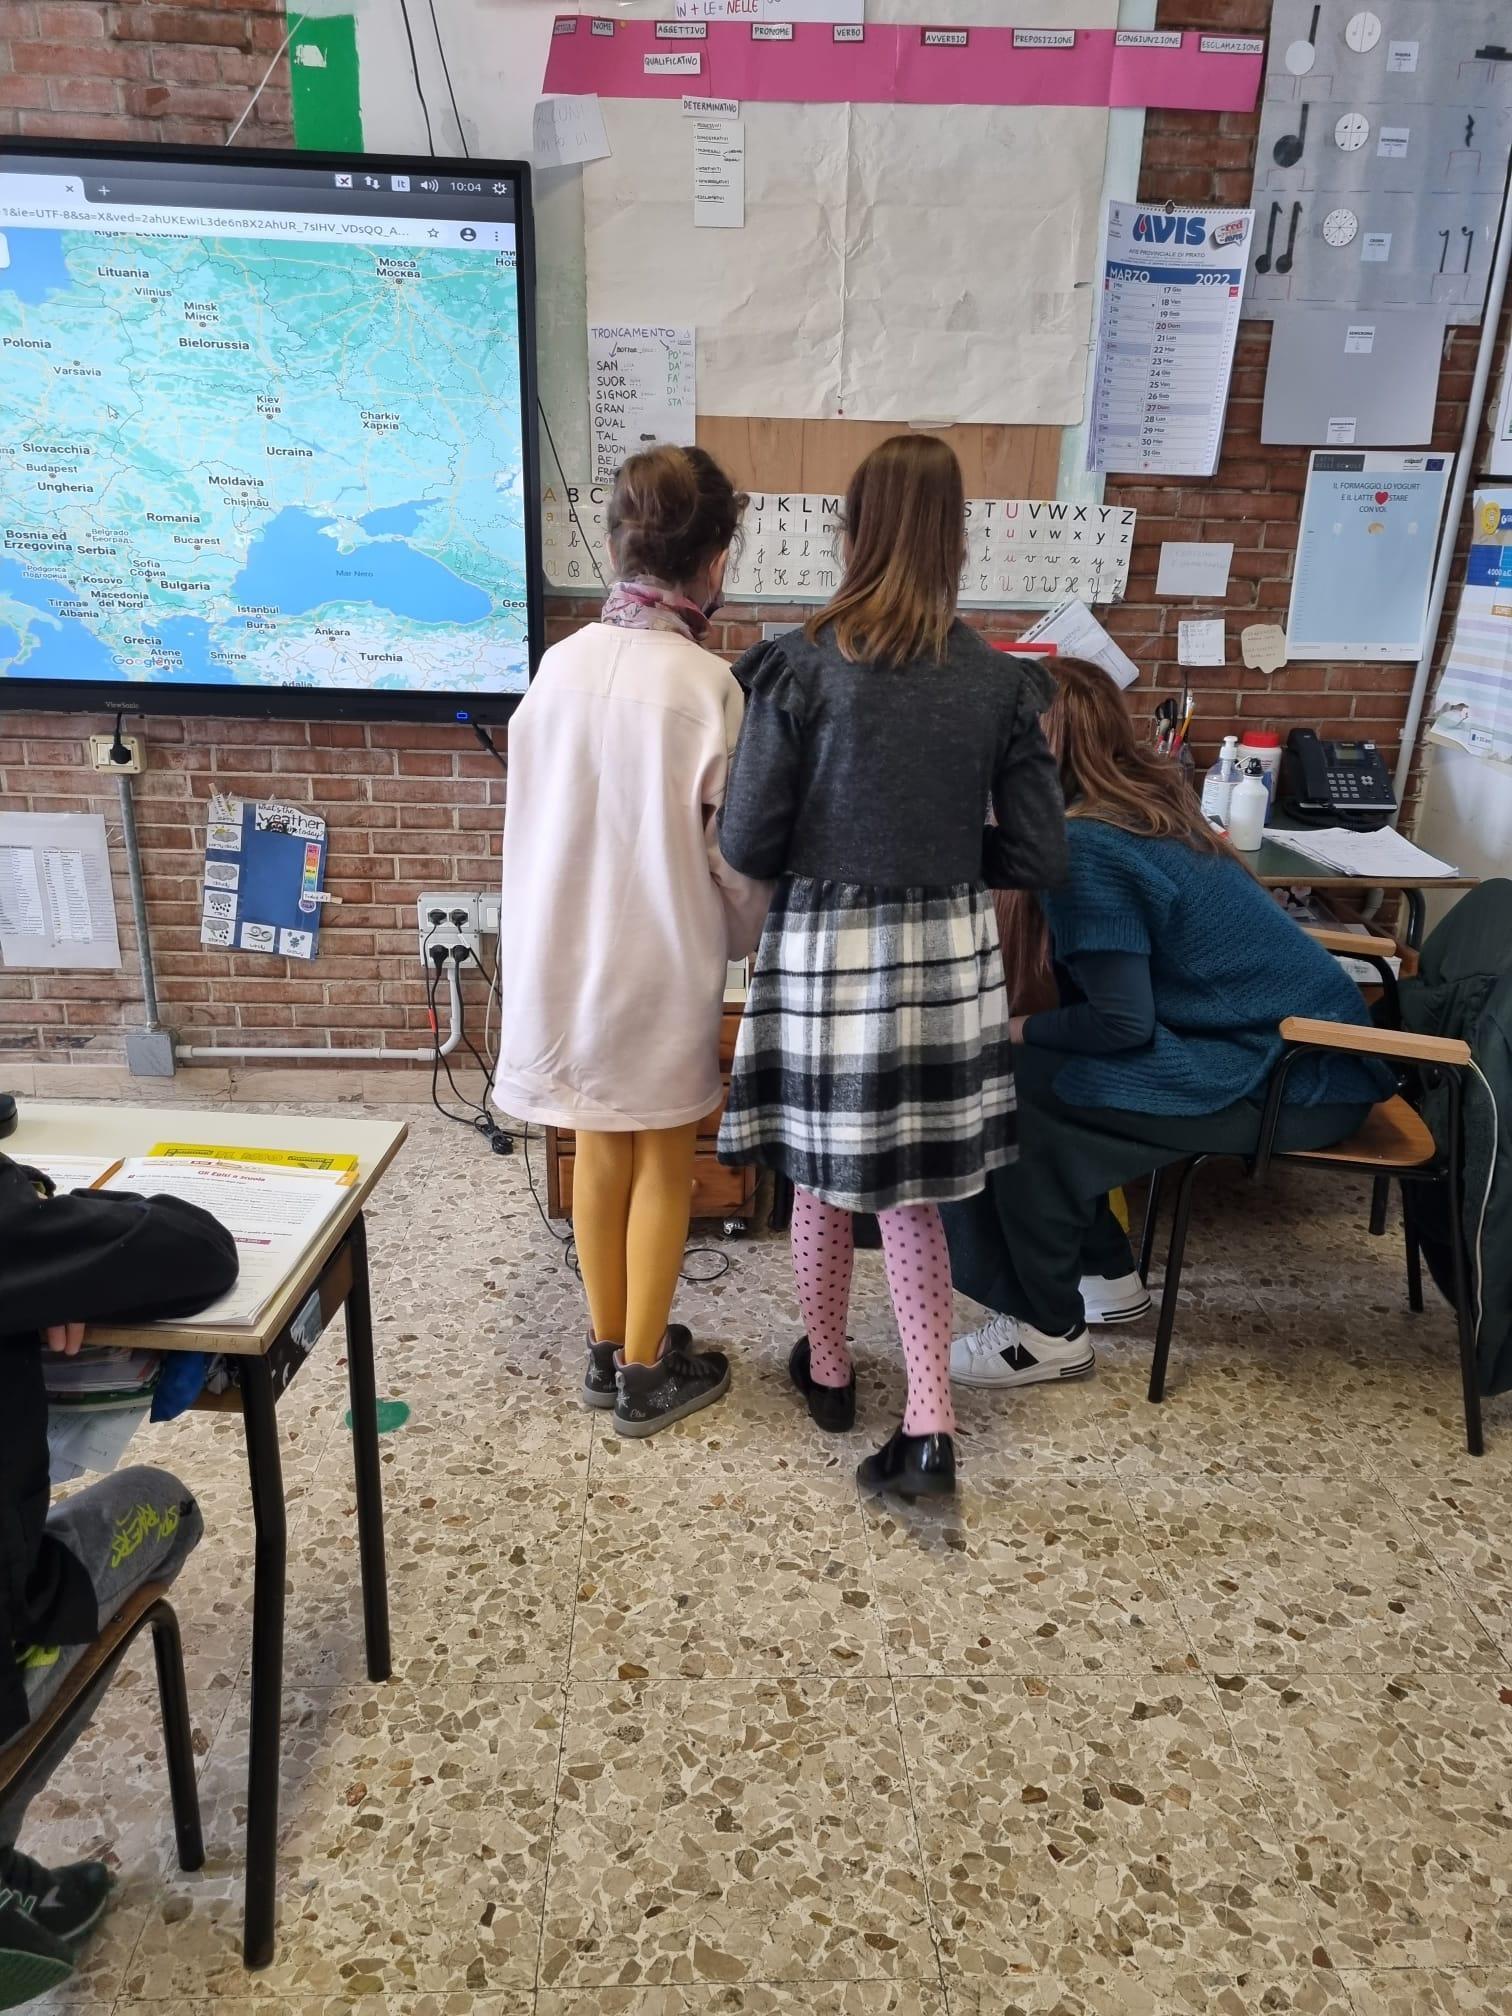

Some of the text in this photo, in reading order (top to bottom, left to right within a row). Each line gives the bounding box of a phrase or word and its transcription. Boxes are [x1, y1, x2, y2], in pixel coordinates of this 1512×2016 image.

[677, 5, 686, 17] IN
[726, 0, 759, 15] NELLE
[593, 22, 612, 31] NOME
[657, 25, 705, 35] AGGETTIVO
[754, 27, 790, 36] PRONOME
[836, 28, 861, 37] VERBO
[926, 34, 966, 43] AVVERBIO
[1015, 34, 1073, 44] PREPOSIZIONE
[1117, 34, 1180, 45] CONGIUNZIONE
[1201, 40, 1261, 52] ESCLAMAZIONE
[644, 55, 698, 66] QUALIFICATIVO
[683, 100, 737, 113] DETERMINATIVO
[450, 181, 482, 192] 10:04
[1132, 213, 1206, 246] AVIS
[379, 258, 417, 268] Mosca
[98, 267, 150, 279] Lituania
[376, 268, 421, 279] Москва
[1110, 268, 1231, 285] MARZO 2022
[135, 287, 173, 297] Vilnius
[184, 302, 218, 312] Minsk
[1156, 322, 1167, 330] 20
[591, 327, 676, 339] TRONCAMENTO
[1157, 334, 1165, 342] 21
[3, 338, 52, 349] Polonia
[179, 337, 250, 350] Bielorussia
[596, 360, 618, 371] SAN
[53, 366, 102, 377] Varsavia
[1150, 369, 1161, 377] 24
[597, 375, 626, 387] SUOR
[256, 395, 280, 404] Kiev
[596, 389, 638, 400] SIGNOR
[1148, 392, 1158, 400] 26
[595, 403, 625, 413] GRAN
[360, 411, 401, 421] Charkiv
[1144, 415, 1155, 423] 28
[594, 416, 626, 428] QUAL
[596, 430, 618, 441] TAL
[1141, 438, 1152, 446] 30
[22, 443, 91, 455] Slovacchia
[266, 446, 314, 458] Ucraina
[597, 443, 626, 454] BUON
[597, 455, 620, 467] BEL
[26, 463, 78, 474] Budapest
[208, 476, 265, 487] Moldavia
[37, 482, 94, 494] Ungheria
[568, 487, 579, 503] B
[590, 487, 604, 504] C
[755, 496, 764, 511] J
[778, 497, 790, 512] K
[802, 497, 812, 513] L
[821, 498, 839, 514] M
[985, 502, 996, 518] T
[1006, 503, 1018, 519] U
[1029, 503, 1041, 519] V
[1048, 504, 1068, 520] W
[1073, 505, 1087, 521] X
[1098, 507, 1111, 523] Y
[1120, 510, 1134, 525] Z
[1359, 505, 1374, 513] CON
[147, 513, 200, 524] Romania
[6, 530, 67, 541] Bosnia ed
[91, 529, 129, 538] Belgrado
[174, 535, 220, 545] Bucarest
[4, 540, 73, 552] Erzegovina
[77, 545, 117, 555] Serbia
[27, 565, 67, 573] Podgorica
[132, 560, 161, 569] Sofia
[130, 568, 166, 578] София
[83, 576, 123, 585] Kosovo
[161, 580, 211, 592] Bulgaria
[91, 590, 149, 600] Macedonia
[49, 599, 83, 607] Tirana
[117, 600, 144, 608] Nord
[59, 610, 99, 618] Albania
[237, 606, 279, 614] Istanbul
[246, 621, 276, 630] Bursa
[314, 627, 351, 637] Ankara
[123, 636, 162, 646] Grecia
[150, 649, 181, 657] Atene
[210, 651, 247, 660] Smirne
[360, 652, 403, 663] Turchia
[112, 654, 164, 668] Google
[281, 680, 313, 688] Adalia
[104, 701, 139, 709] ViewSonic
[258, 812, 325, 830] weather
